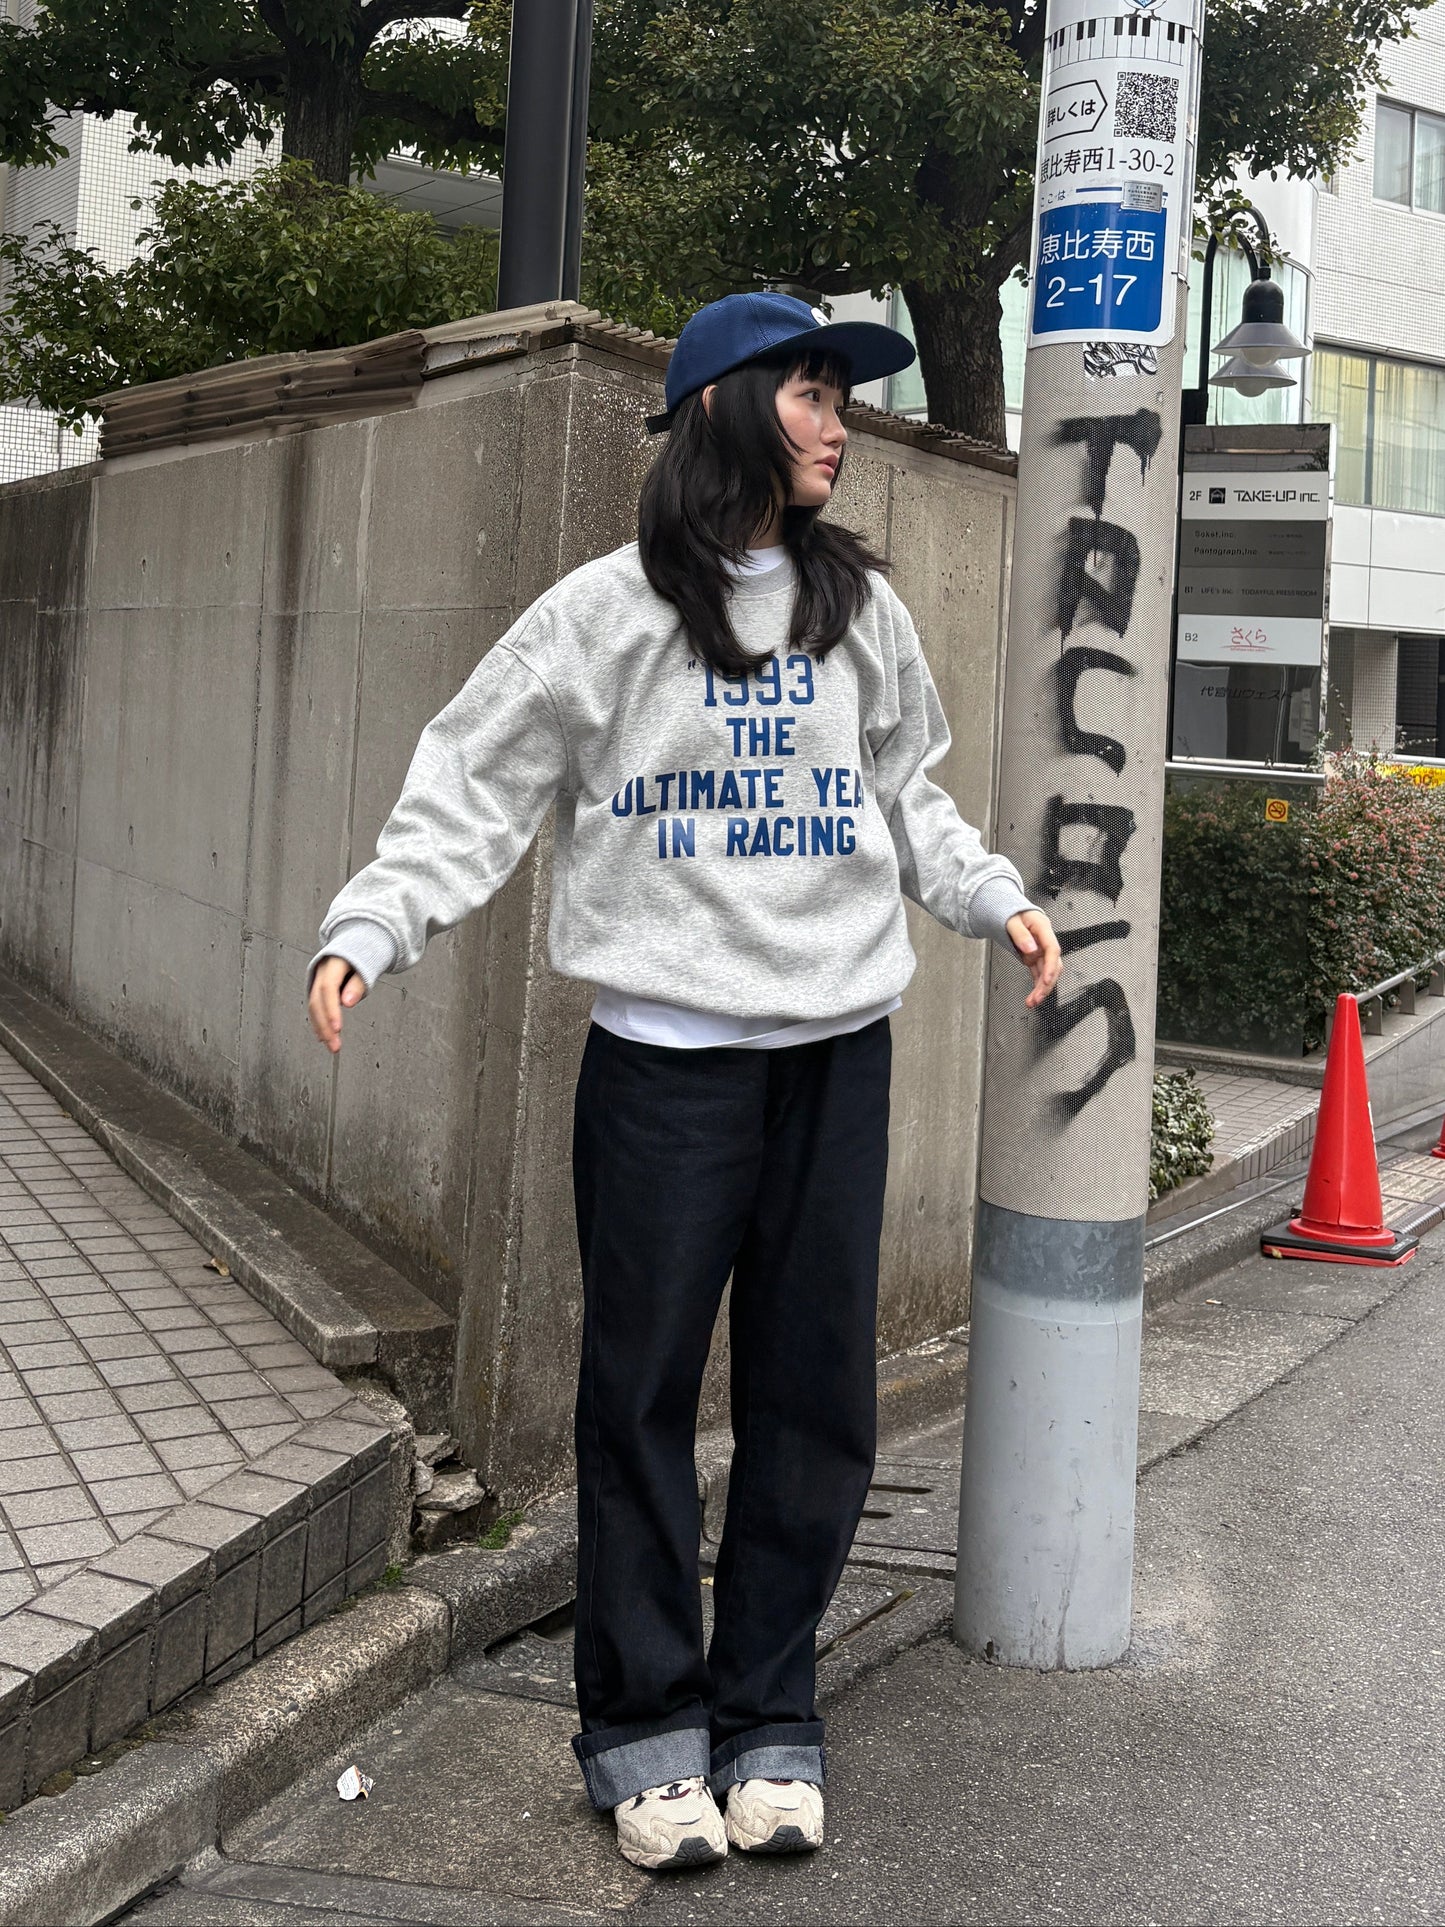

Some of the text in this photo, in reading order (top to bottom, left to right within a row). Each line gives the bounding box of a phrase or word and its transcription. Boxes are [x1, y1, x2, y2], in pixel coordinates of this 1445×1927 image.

[1040, 229, 1156, 263] 恵比寿西
[1046, 274, 1138, 309] 2-17
[1189, 490, 1202, 501] 2F
[1184, 626, 1267, 646] B2 さくら
[726, 717, 796, 758] THE
[611, 768, 784, 818] ULTIMATE
[657, 816, 856, 859] IN RACING
